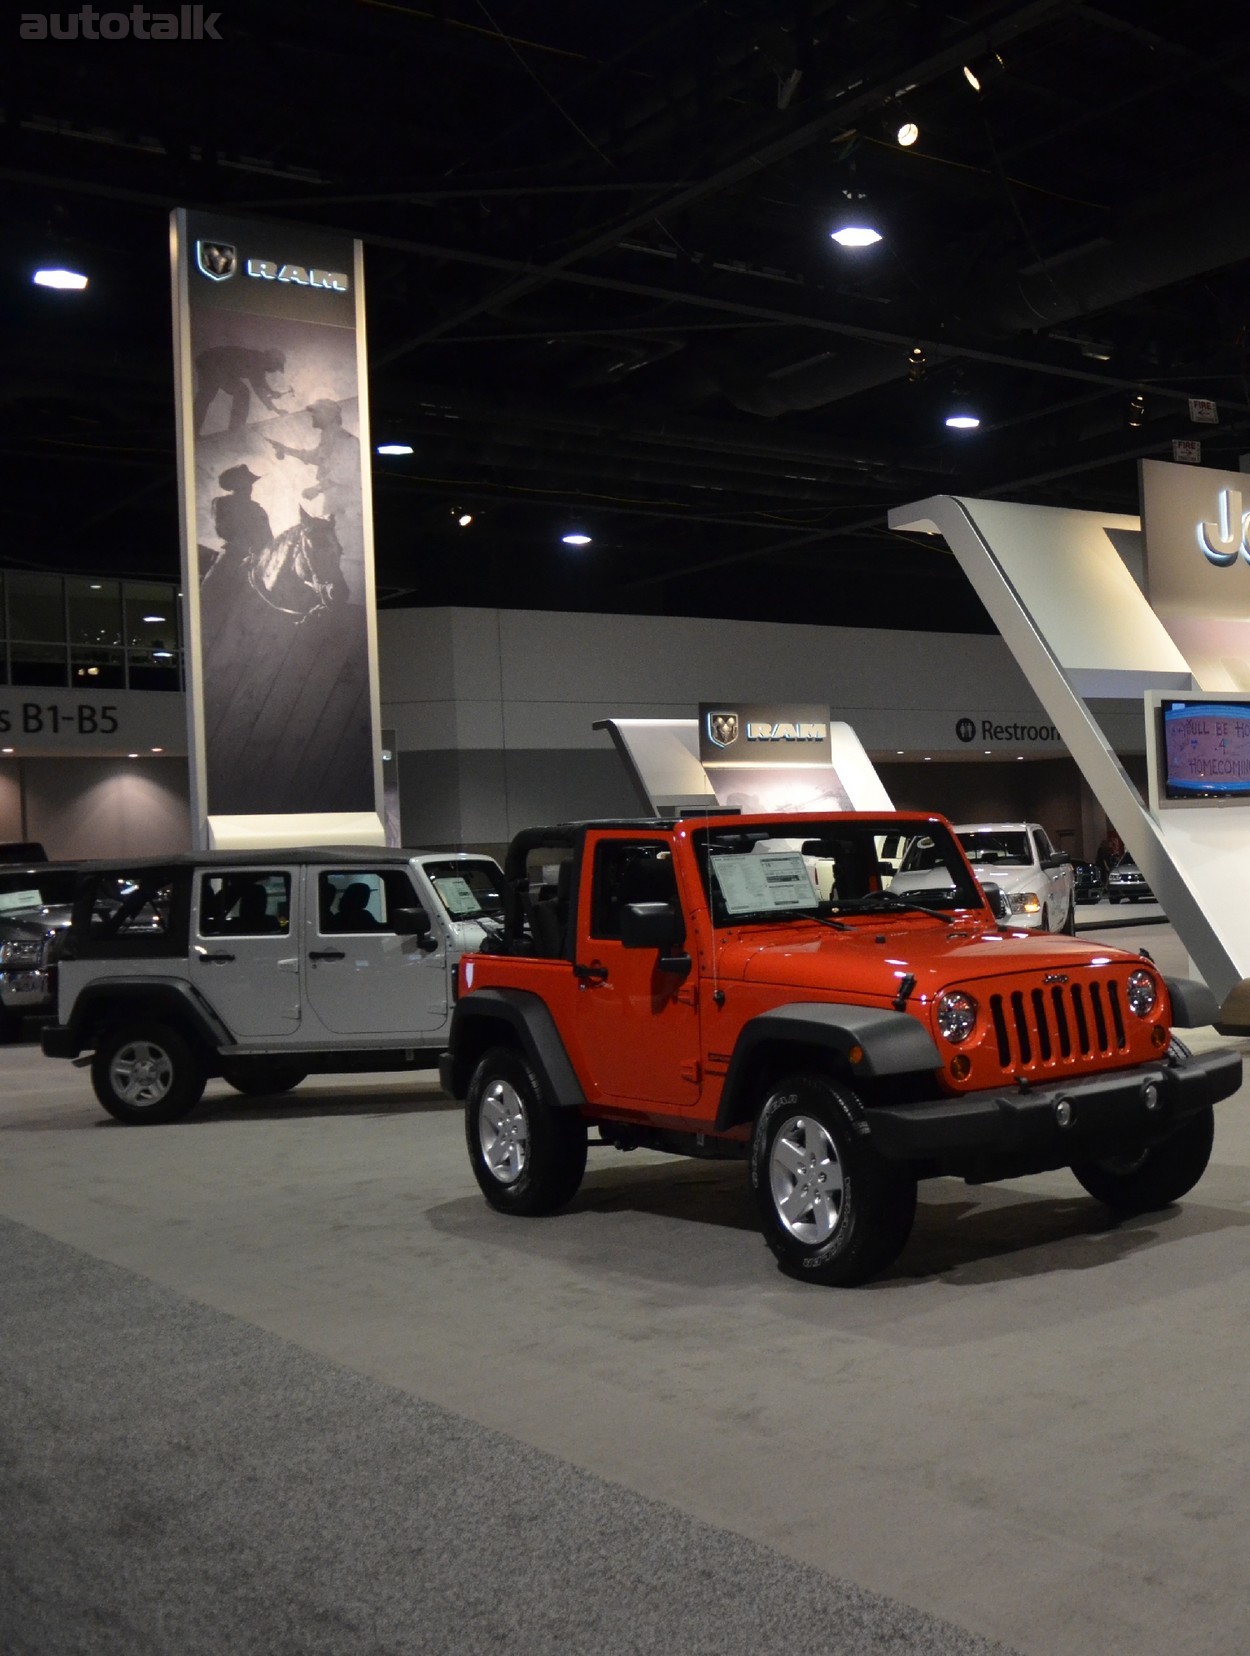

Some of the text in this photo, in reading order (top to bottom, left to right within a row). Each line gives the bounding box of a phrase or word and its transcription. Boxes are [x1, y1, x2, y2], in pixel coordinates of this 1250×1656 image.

[247, 259, 348, 292] RAM
[1193, 400, 1212, 410] FIRE
[1177, 440, 1196, 449] FIRE
[22, 703, 118, 734] B1-B5
[746, 723, 826, 741] RAM
[1216, 721, 1228, 736] BE
